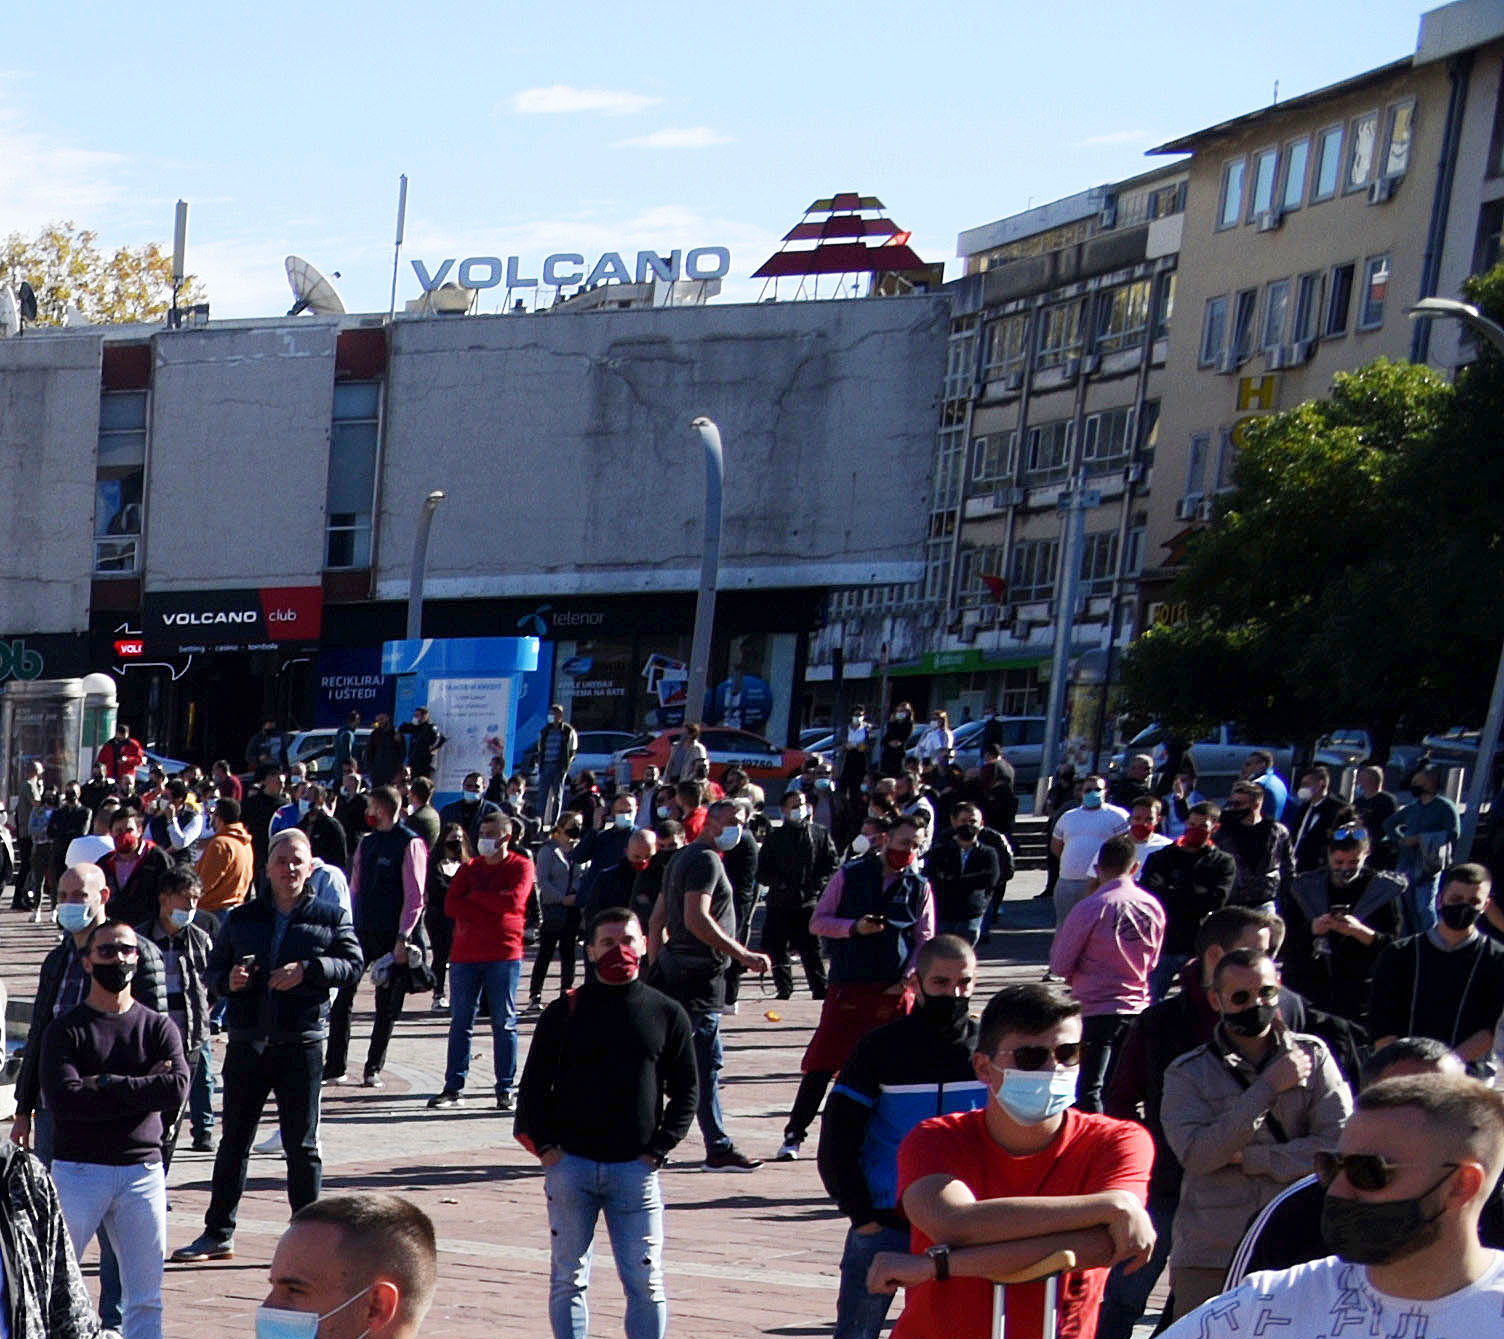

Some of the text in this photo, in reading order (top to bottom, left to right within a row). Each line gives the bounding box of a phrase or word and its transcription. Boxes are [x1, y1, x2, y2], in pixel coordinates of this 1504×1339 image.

[410, 246, 731, 291] VOLCANO
[162, 609, 297, 626] VOLCANO club
[553, 610, 607, 626] telenor
[321, 674, 385, 688] RECIKLIRAJ
